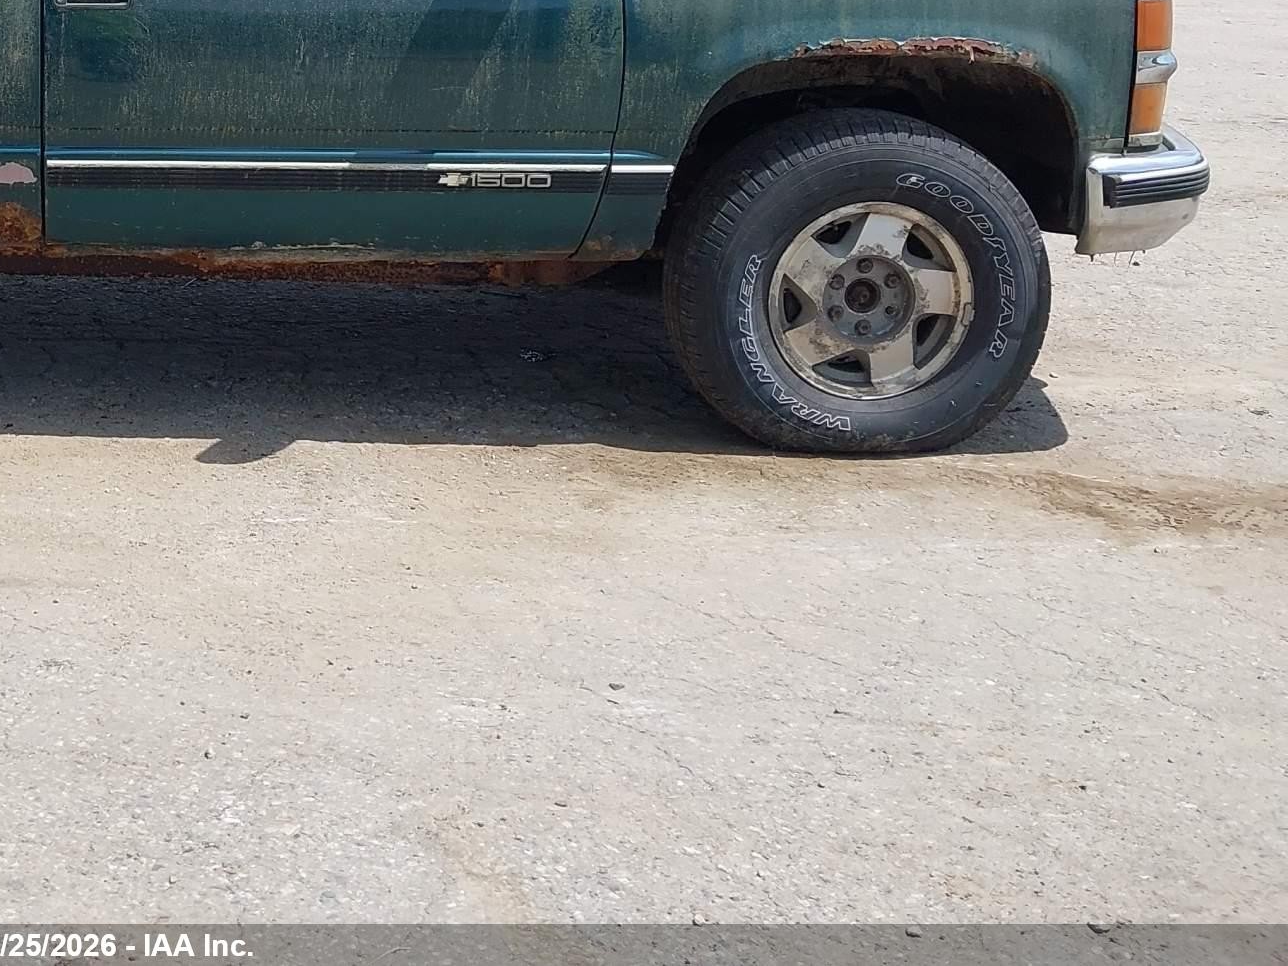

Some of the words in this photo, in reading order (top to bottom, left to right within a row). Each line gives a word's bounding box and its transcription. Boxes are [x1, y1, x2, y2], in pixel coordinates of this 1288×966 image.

[468, 172, 552, 188] 1500
[895, 172, 1016, 359] GOODYEAR
[737, 254, 853, 432] WRANGLER
